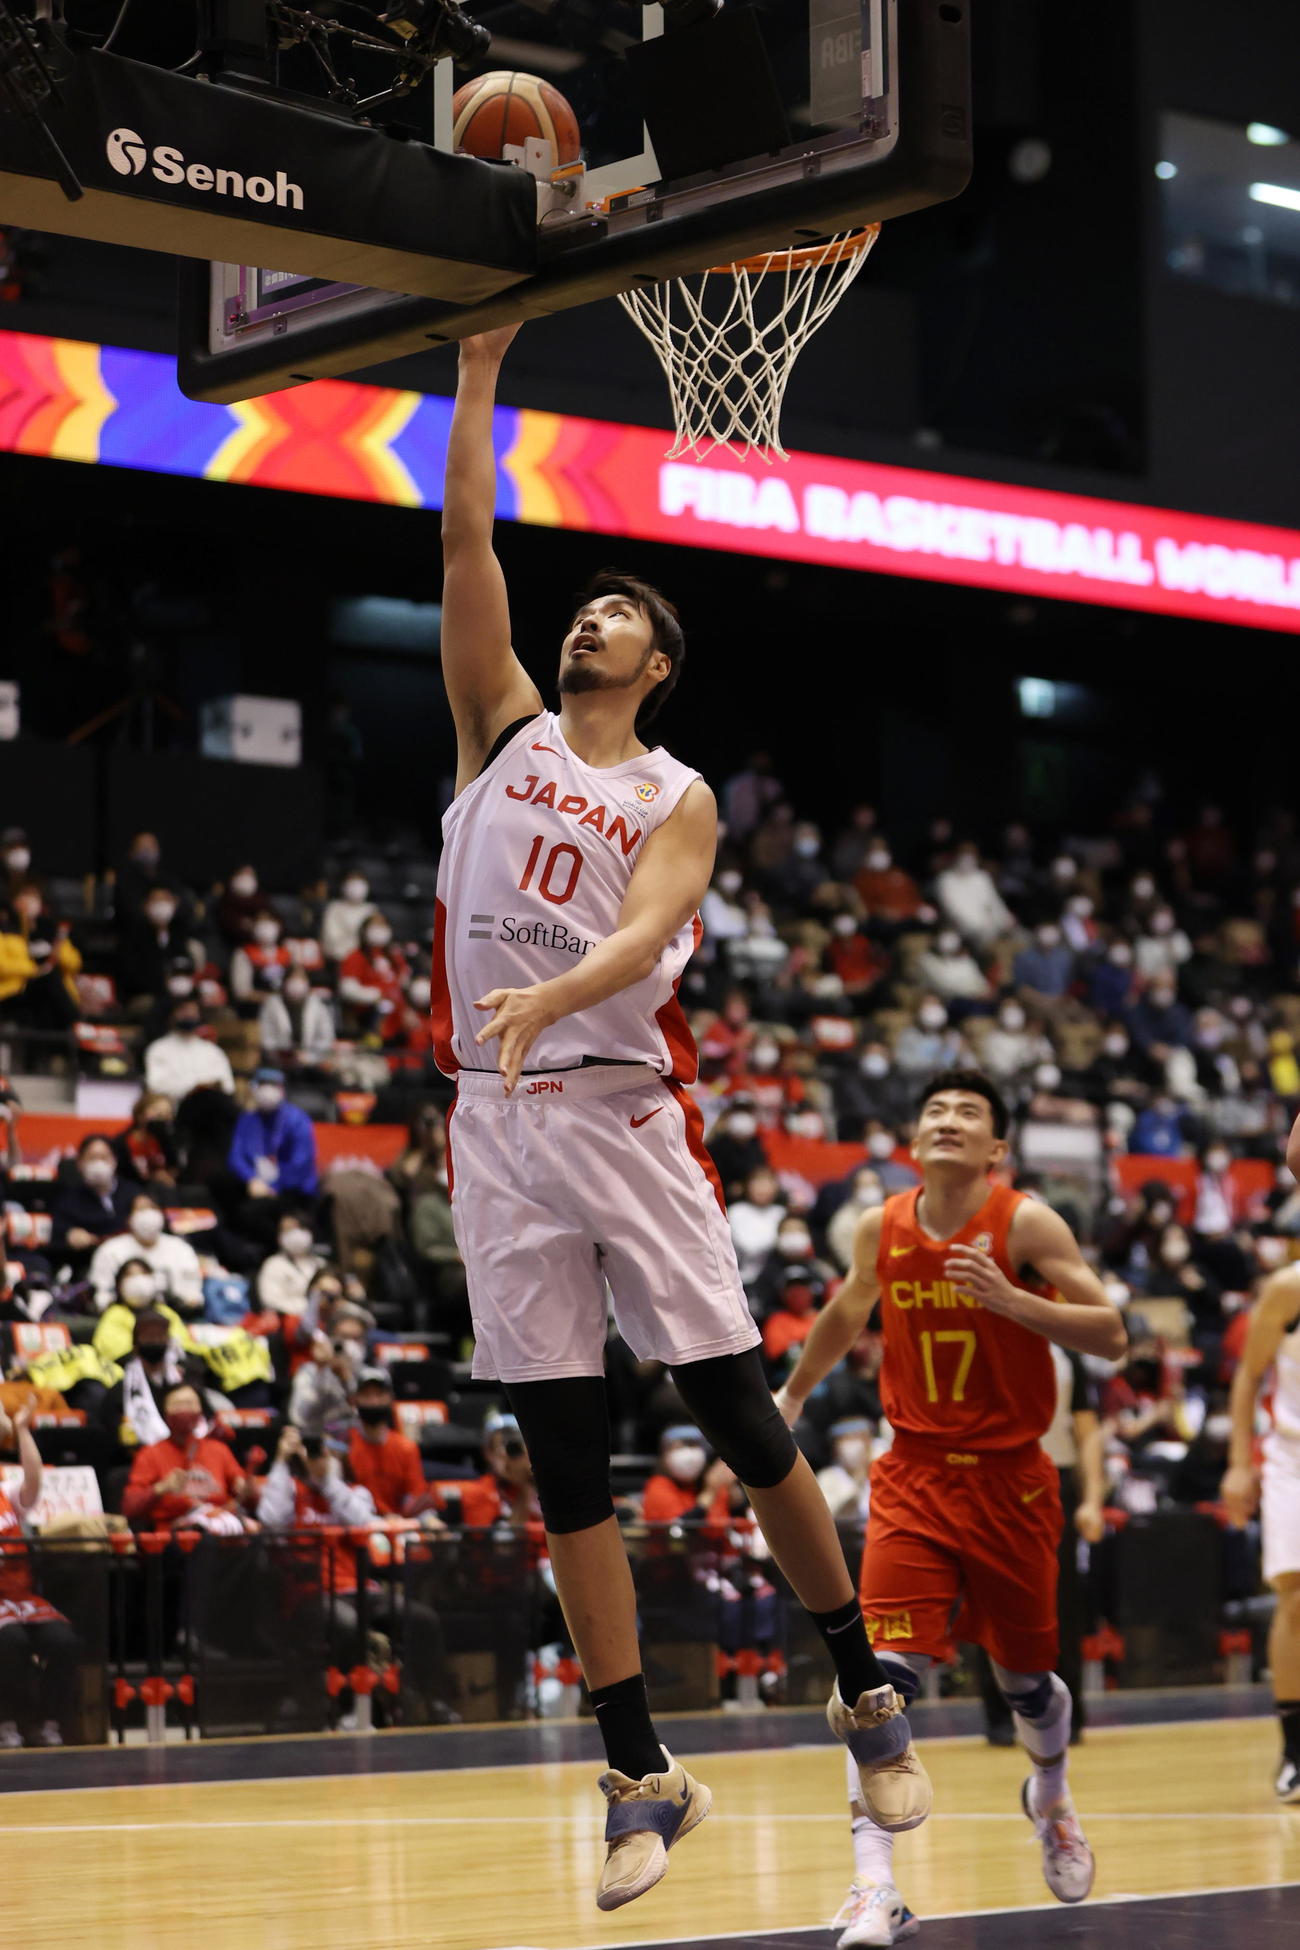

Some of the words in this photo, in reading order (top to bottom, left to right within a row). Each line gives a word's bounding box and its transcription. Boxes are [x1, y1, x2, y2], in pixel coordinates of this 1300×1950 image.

[152, 146, 304, 210] Senoh
[659, 462, 800, 533] FIBA
[804, 483, 1153, 586] BASKETBALL
[505, 775, 641, 856] JAPAN
[519, 835, 583, 905] 10
[500, 917, 597, 956] SoftBan
[526, 1081, 563, 1095] JPN
[891, 1281, 985, 1309] CHIN
[920, 1330, 977, 1403] 17
